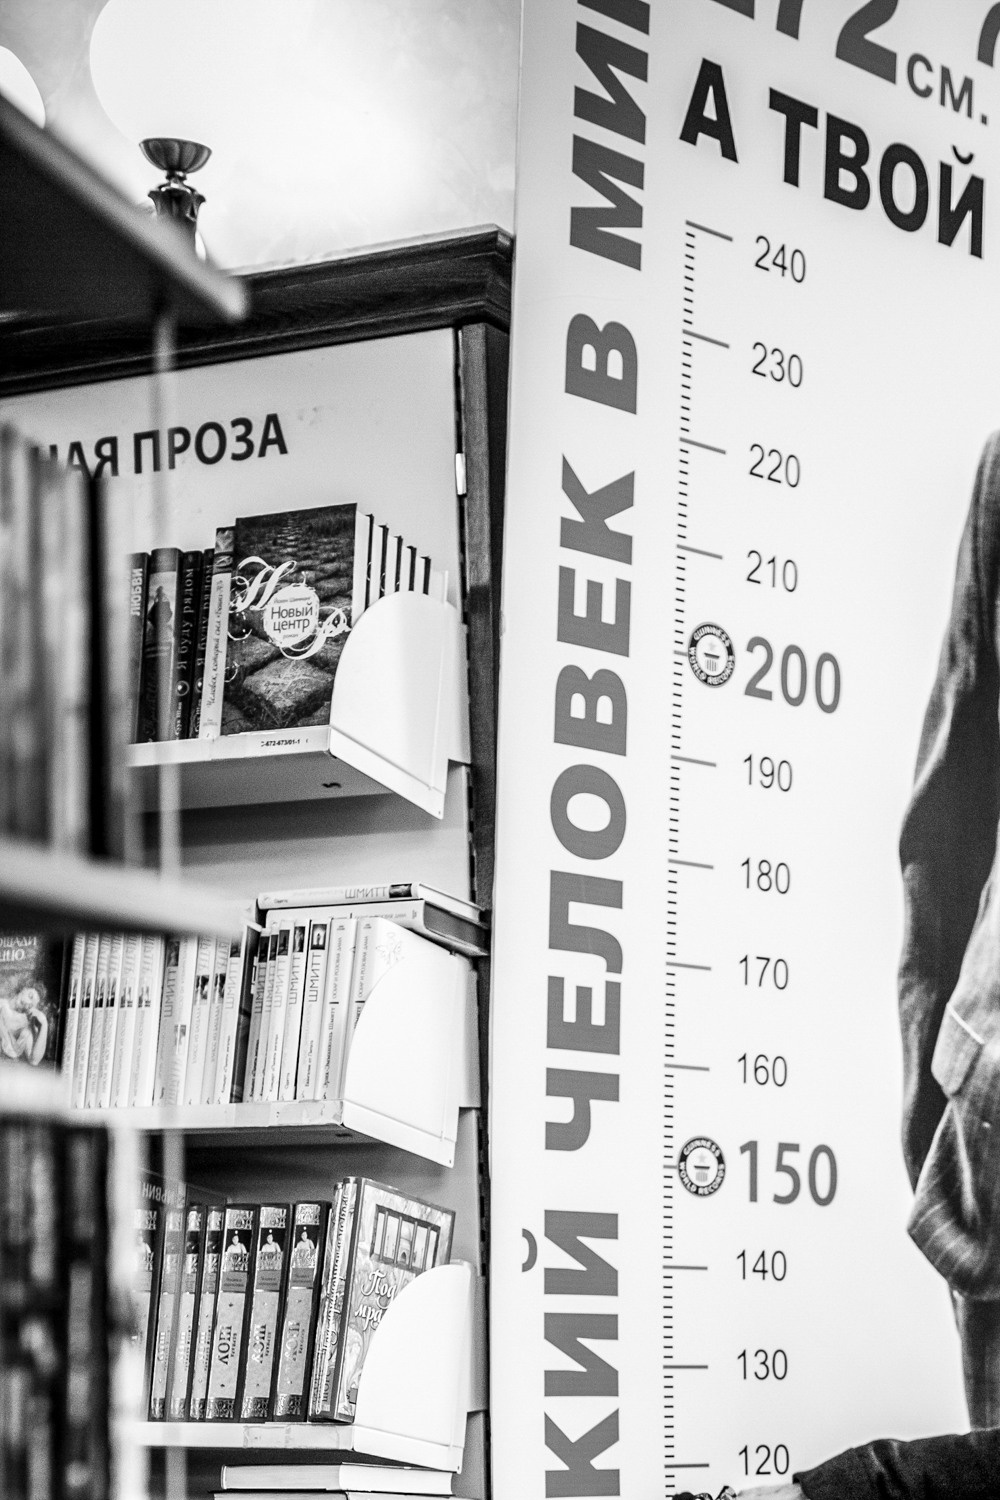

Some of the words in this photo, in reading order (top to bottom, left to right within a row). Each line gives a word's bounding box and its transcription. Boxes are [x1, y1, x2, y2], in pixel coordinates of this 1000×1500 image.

[569, 0, 651, 272] МИ
[679, 57, 739, 164] А
[768, 86, 985, 260] ТВОЙ
[754, 235, 807, 284] 240
[565, 312, 639, 416] В
[750, 341, 804, 389] 230
[133, 411, 289, 475] ПРОЗА
[748, 442, 802, 489] 220
[130, 567, 144, 617] ЛЮБВИ
[183, 567, 195, 615] рядом
[745, 548, 799, 595] 210
[271, 602, 313, 620] Новый
[273, 618, 310, 633] центр
[180, 617, 194, 655] буду
[745, 635, 842, 714] 200
[743, 753, 794, 793] 190
[545, 454, 637, 1152] ЧЕЛОВЕК
[344, 886, 388, 899] ШМИТТ
[740, 857, 792, 895] 180
[163, 965, 178, 1018] ШМИТТ
[225, 959, 240, 1010] ШМИТТ
[255, 964, 267, 1014] ШМИТТ
[273, 958, 286, 1008] ШМИТТ
[288, 954, 301, 1005] ШМИТТ
[308, 953, 322, 1002] ШМИТТ
[739, 955, 790, 991] 170
[738, 1052, 789, 1088] 160
[739, 1139, 839, 1208] 150
[361, 1269, 397, 1308] Под
[736, 1250, 788, 1282] 140
[737, 1348, 790, 1382] 130
[738, 1444, 791, 1477] 120
